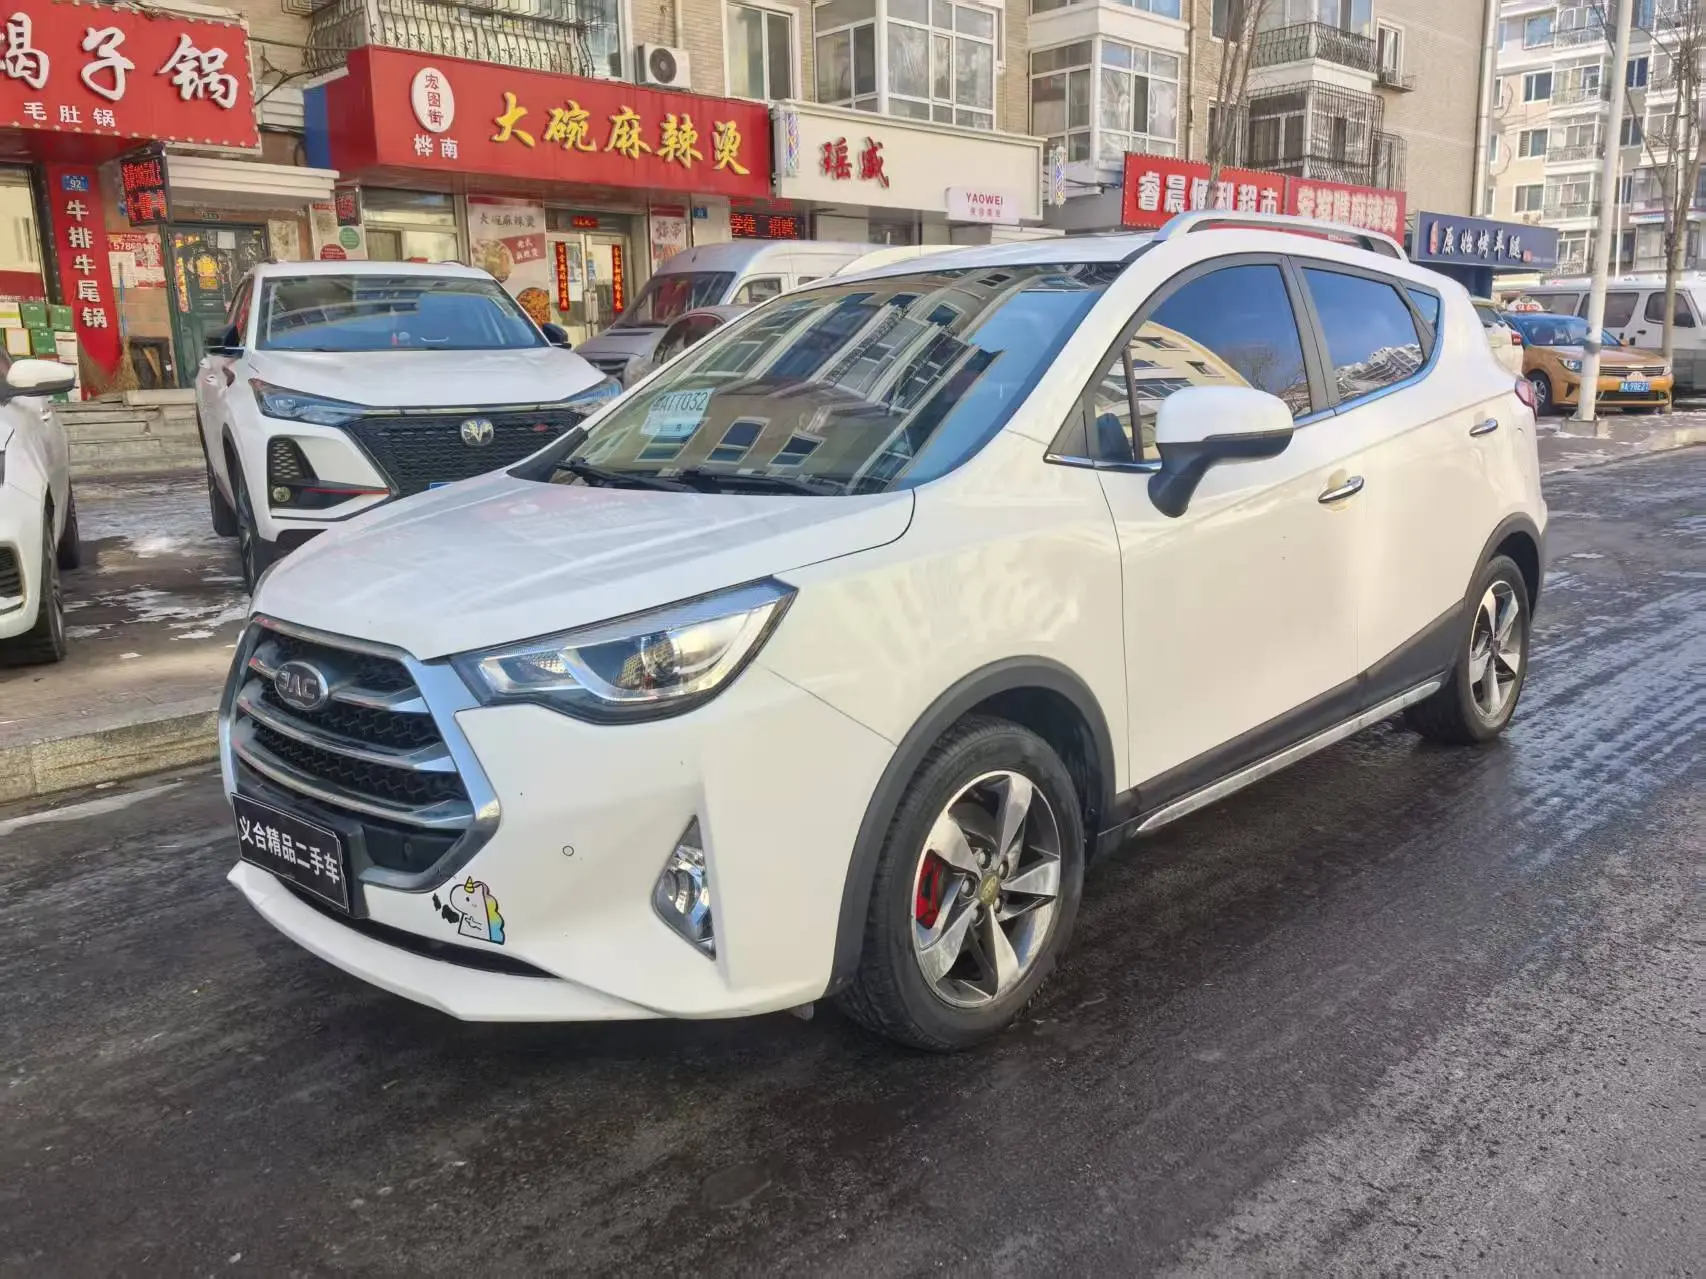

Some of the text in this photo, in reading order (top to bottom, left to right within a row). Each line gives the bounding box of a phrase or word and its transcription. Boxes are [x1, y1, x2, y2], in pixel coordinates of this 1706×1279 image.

[23, 101, 117, 128] 毛肚锅
[425, 73, 444, 126] 宏图街
[413, 133, 459, 159] 桦南
[490, 91, 751, 175] 大碗麻辣烫
[70, 179, 82, 189] 92
[818, 136, 889, 188] 瑶威
[966, 192, 1004, 206] YAOWEI
[66, 199, 108, 328] 牛排牛尾锅
[240, 815, 341, 885] 义合精品二手车
